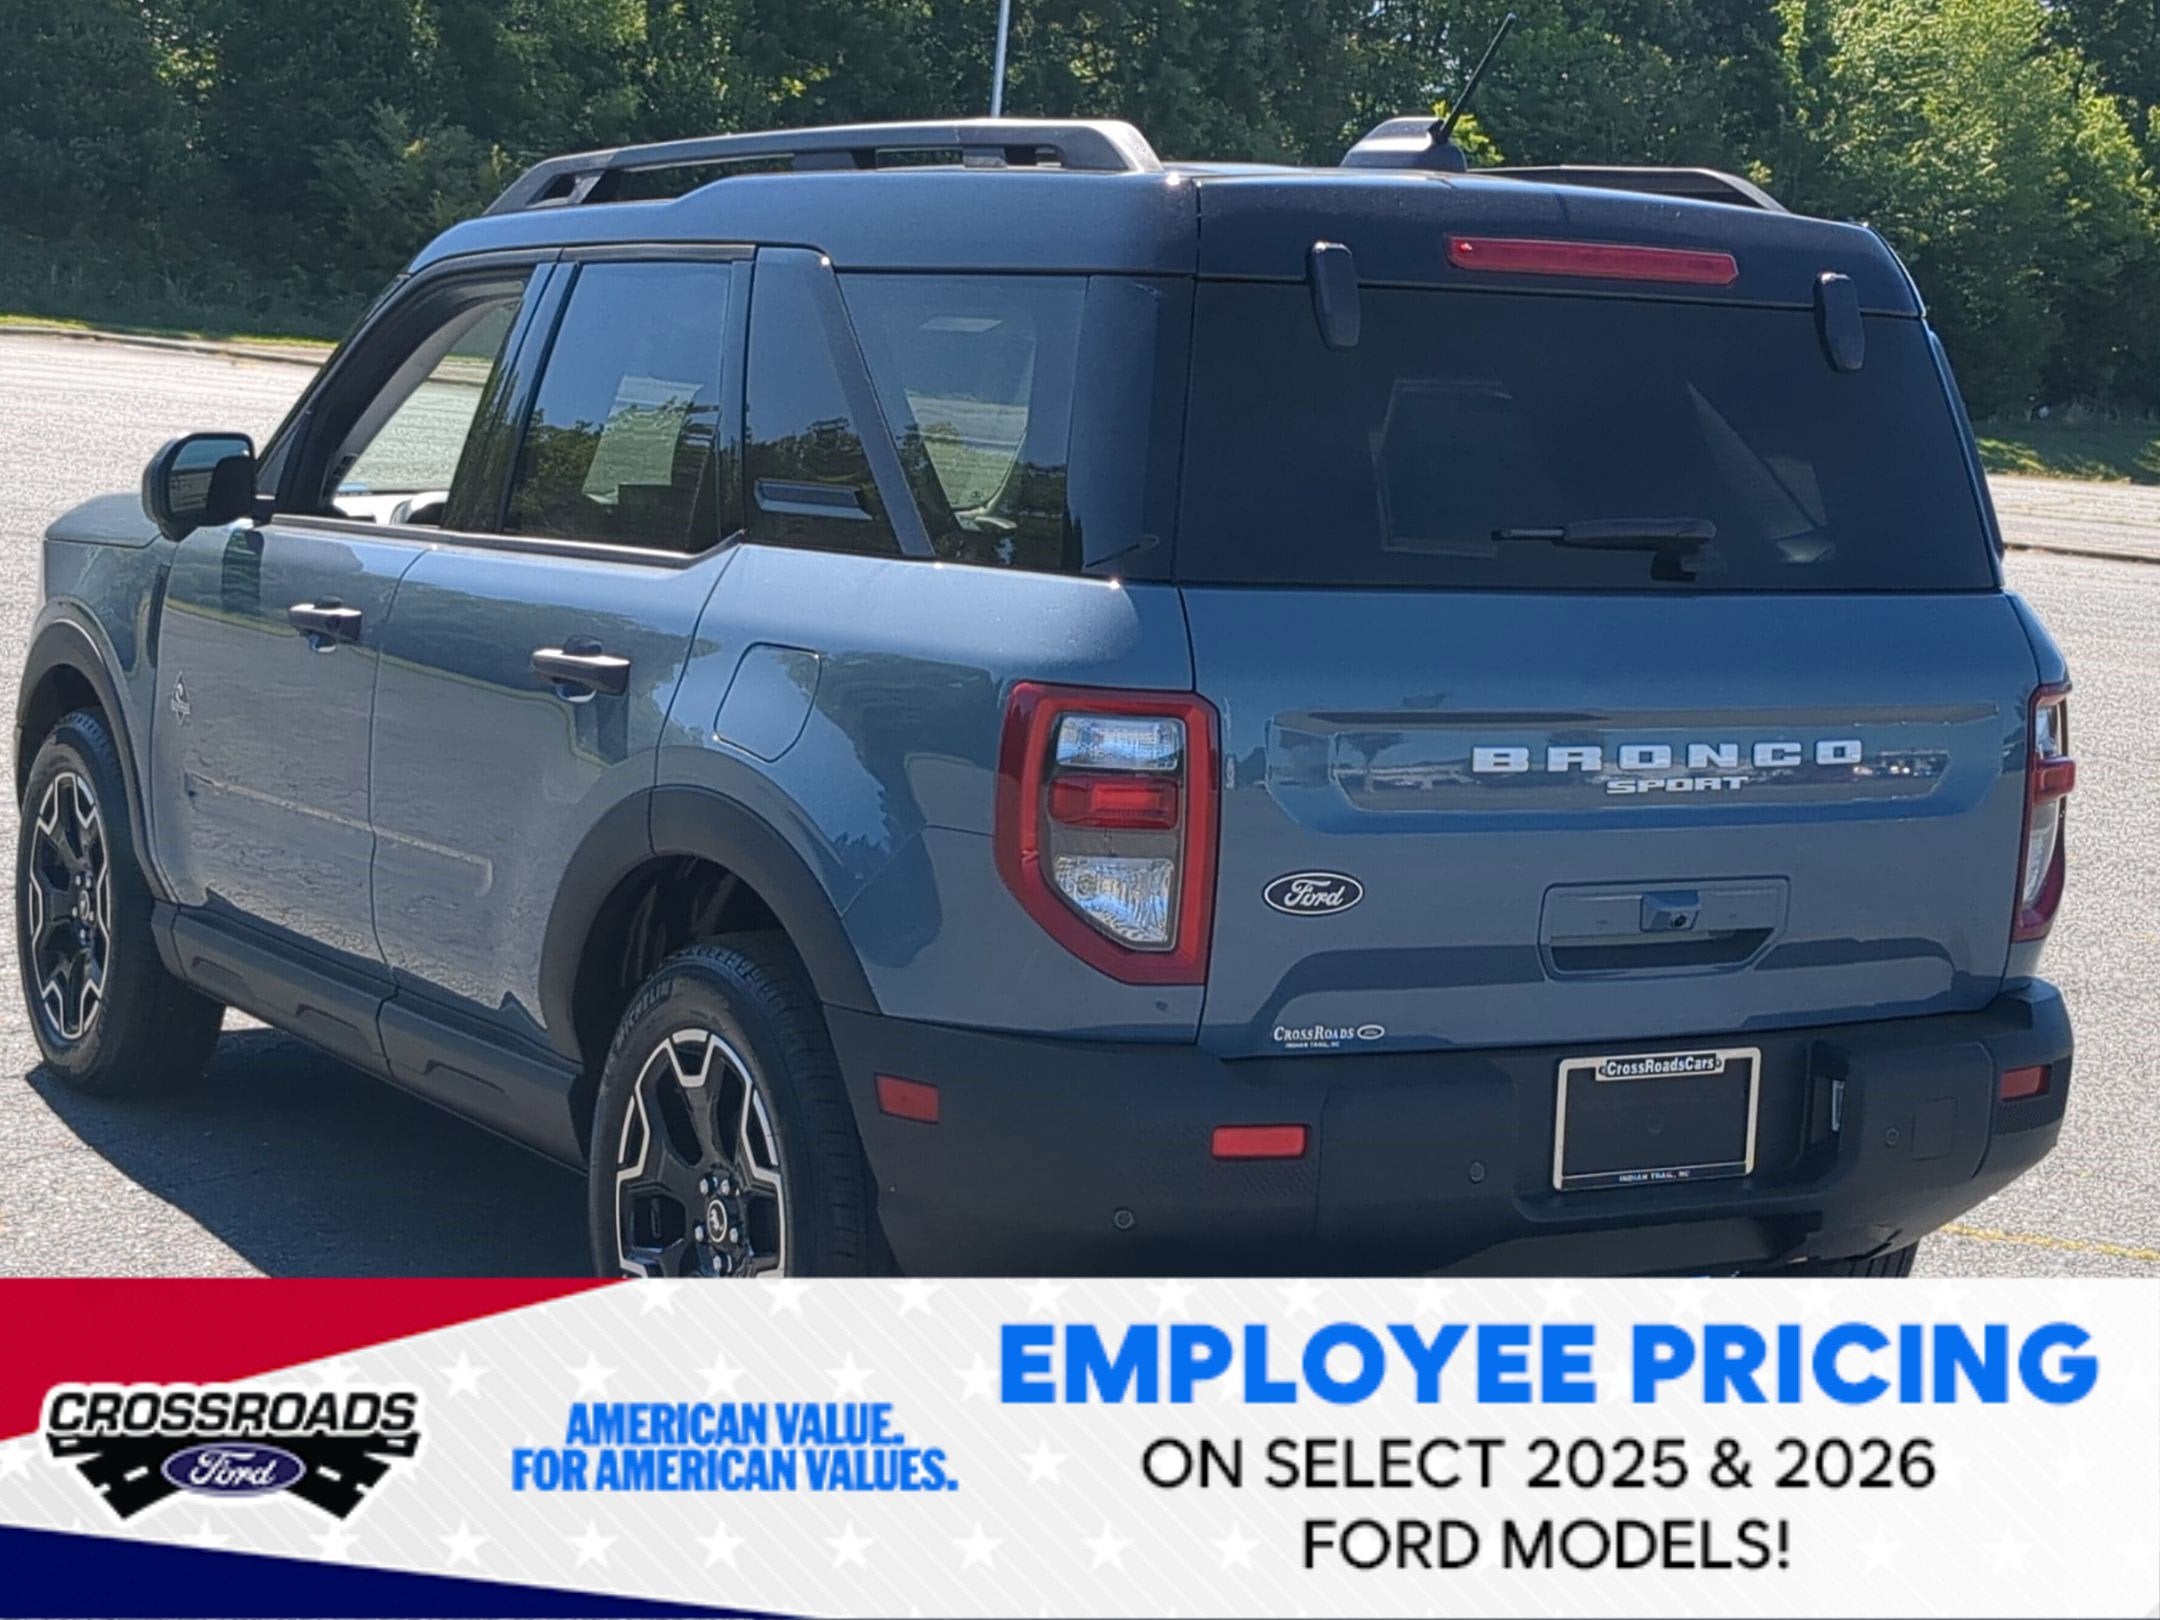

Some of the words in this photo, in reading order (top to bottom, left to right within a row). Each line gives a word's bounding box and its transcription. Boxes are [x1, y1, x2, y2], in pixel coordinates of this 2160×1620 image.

[1472, 739, 1863, 773] BRONCO
[1606, 776, 1749, 795] SPORT
[1283, 879, 1346, 907] Ford
[1607, 1056, 1715, 1076] CrossRoadsCars
